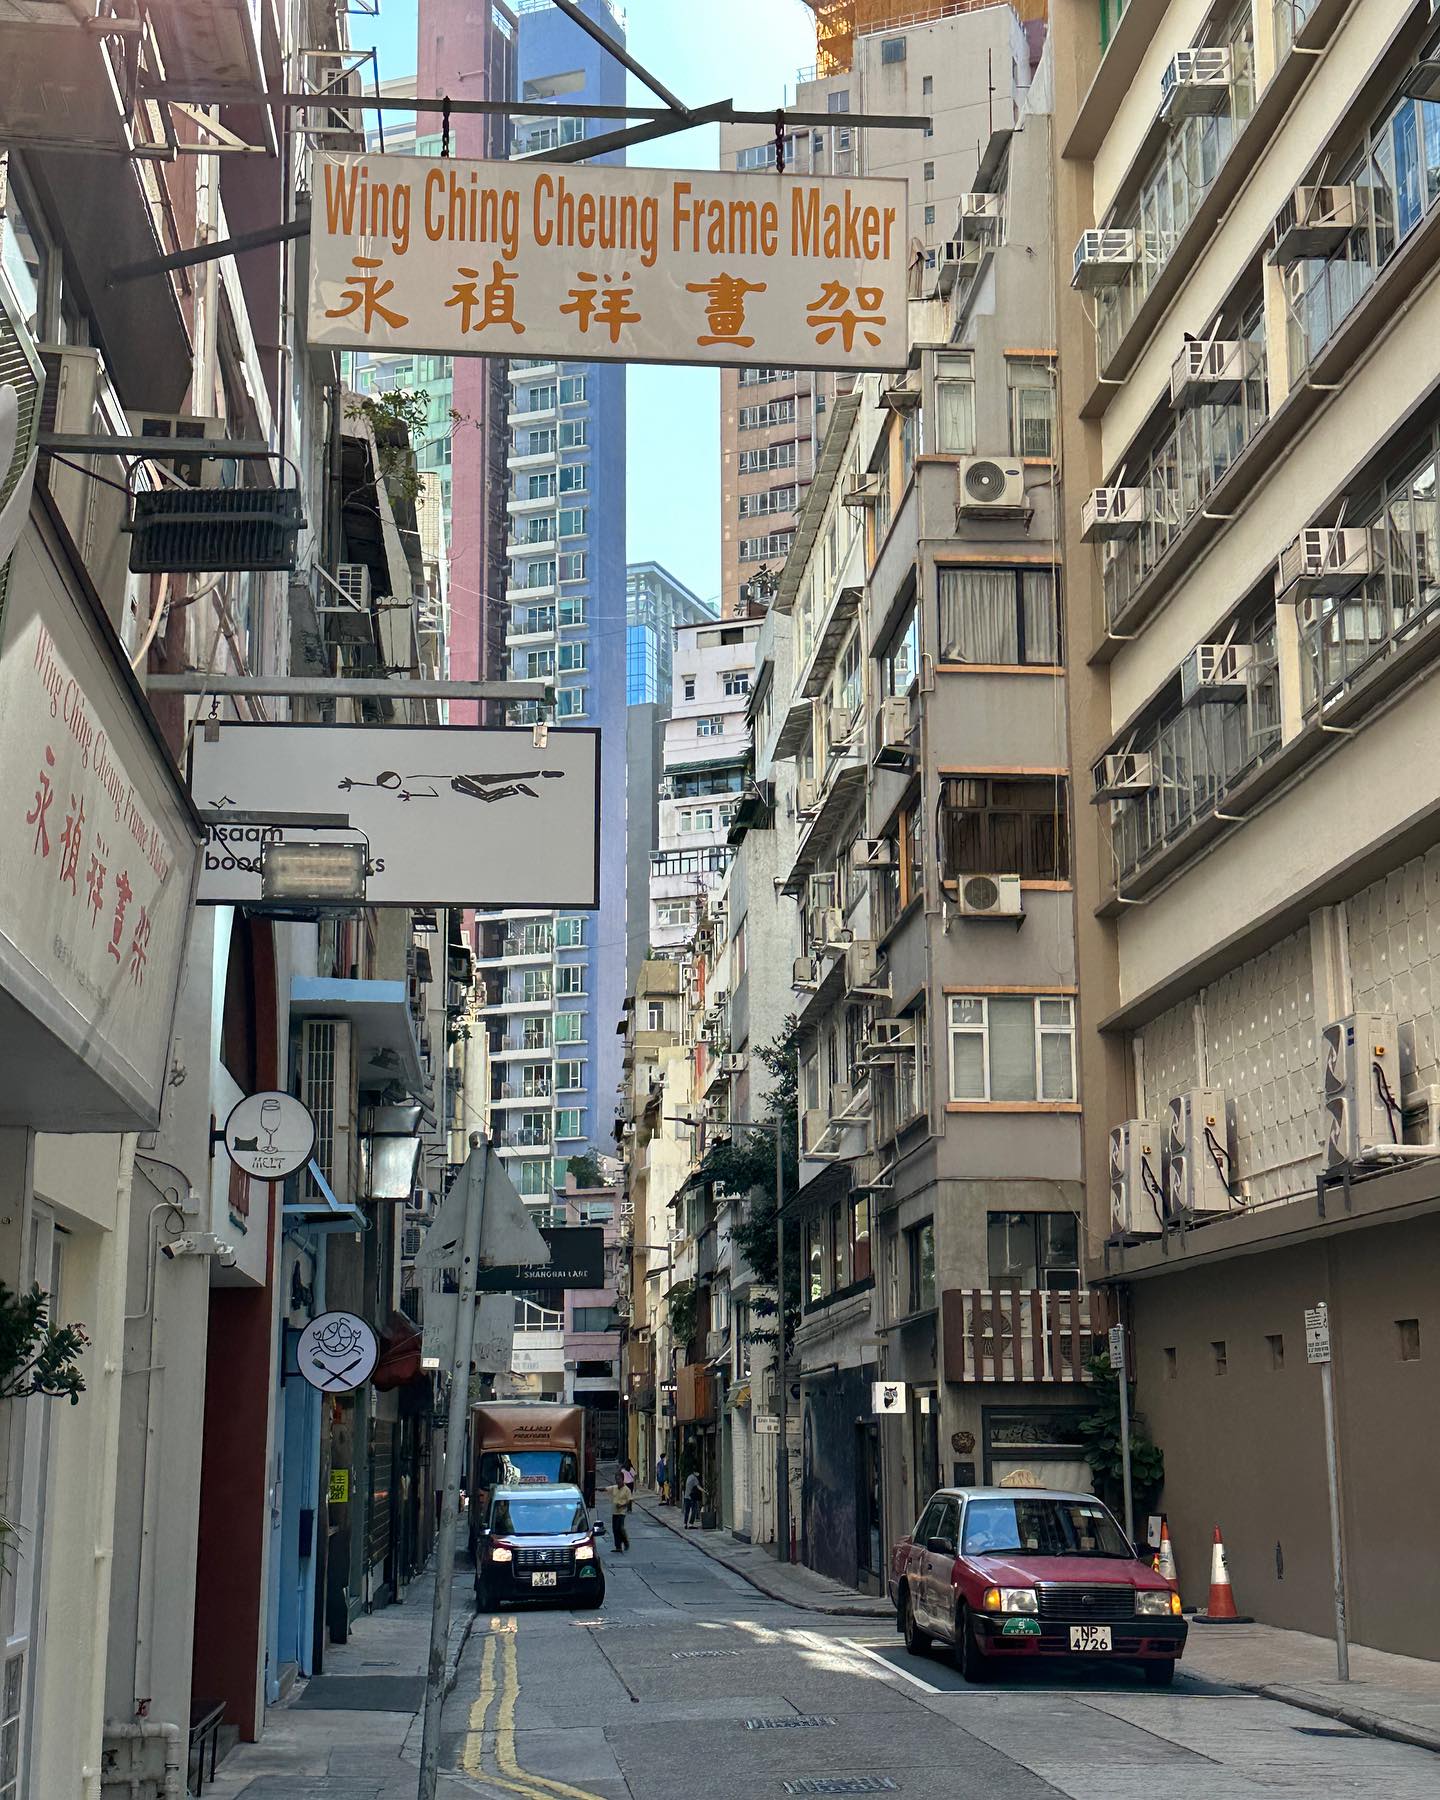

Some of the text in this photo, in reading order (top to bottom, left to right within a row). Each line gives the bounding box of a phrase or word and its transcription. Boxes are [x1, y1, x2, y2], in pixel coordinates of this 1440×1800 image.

[324, 164, 897, 268] Wing Ching Cheung Frame Maker
[325, 256, 887, 353] 永禎祥畫架
[34, 622, 64, 718] Wing
[63, 679, 94, 769] Ching
[93, 730, 125, 823] Cheung
[524, 1270, 566, 1279] SHANGHAI
[1072, 1638, 1109, 1650] 4726
[1080, 1626, 1099, 1639] NP
